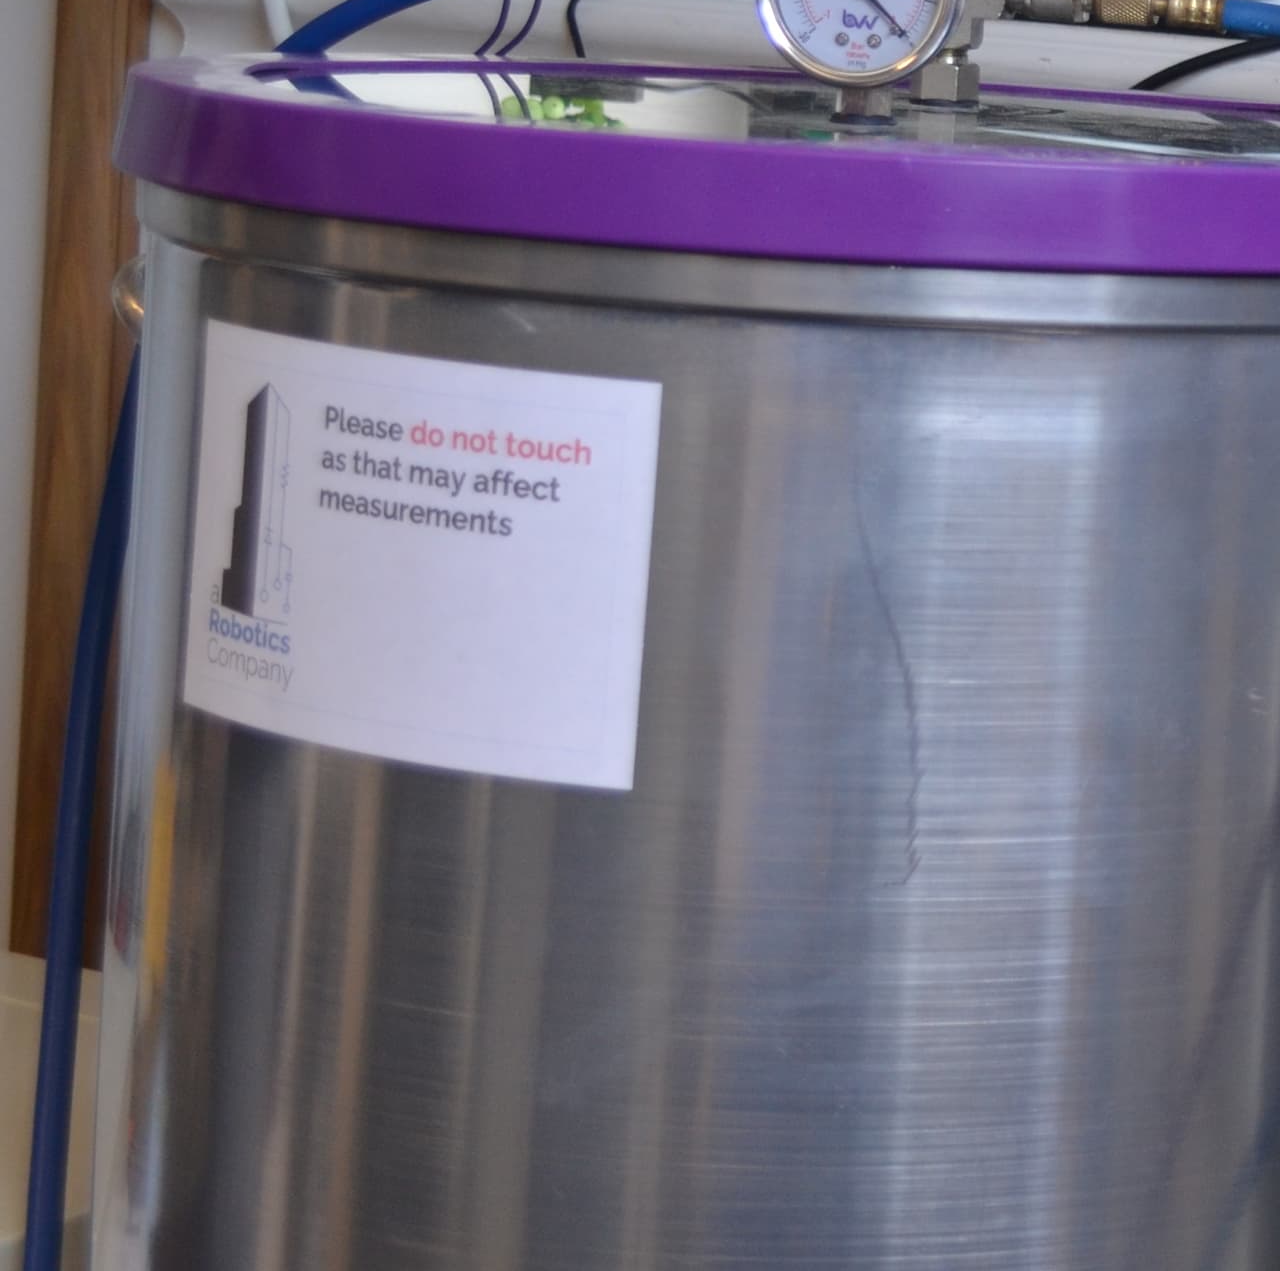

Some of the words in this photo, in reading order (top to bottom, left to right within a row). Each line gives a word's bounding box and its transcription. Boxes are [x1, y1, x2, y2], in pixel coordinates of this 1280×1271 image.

[325, 405, 404, 442] Please
[410, 420, 443, 447] do
[452, 429, 498, 456] not
[506, 432, 592, 466] touch
[321, 449, 346, 473] as
[353, 454, 402, 483] that
[409, 465, 466, 498] may
[473, 470, 562, 503] affect
[319, 487, 514, 538] measurements
[210, 583, 220, 605] a
[209, 608, 292, 657] Robotics
[206, 636, 294, 692] Company
